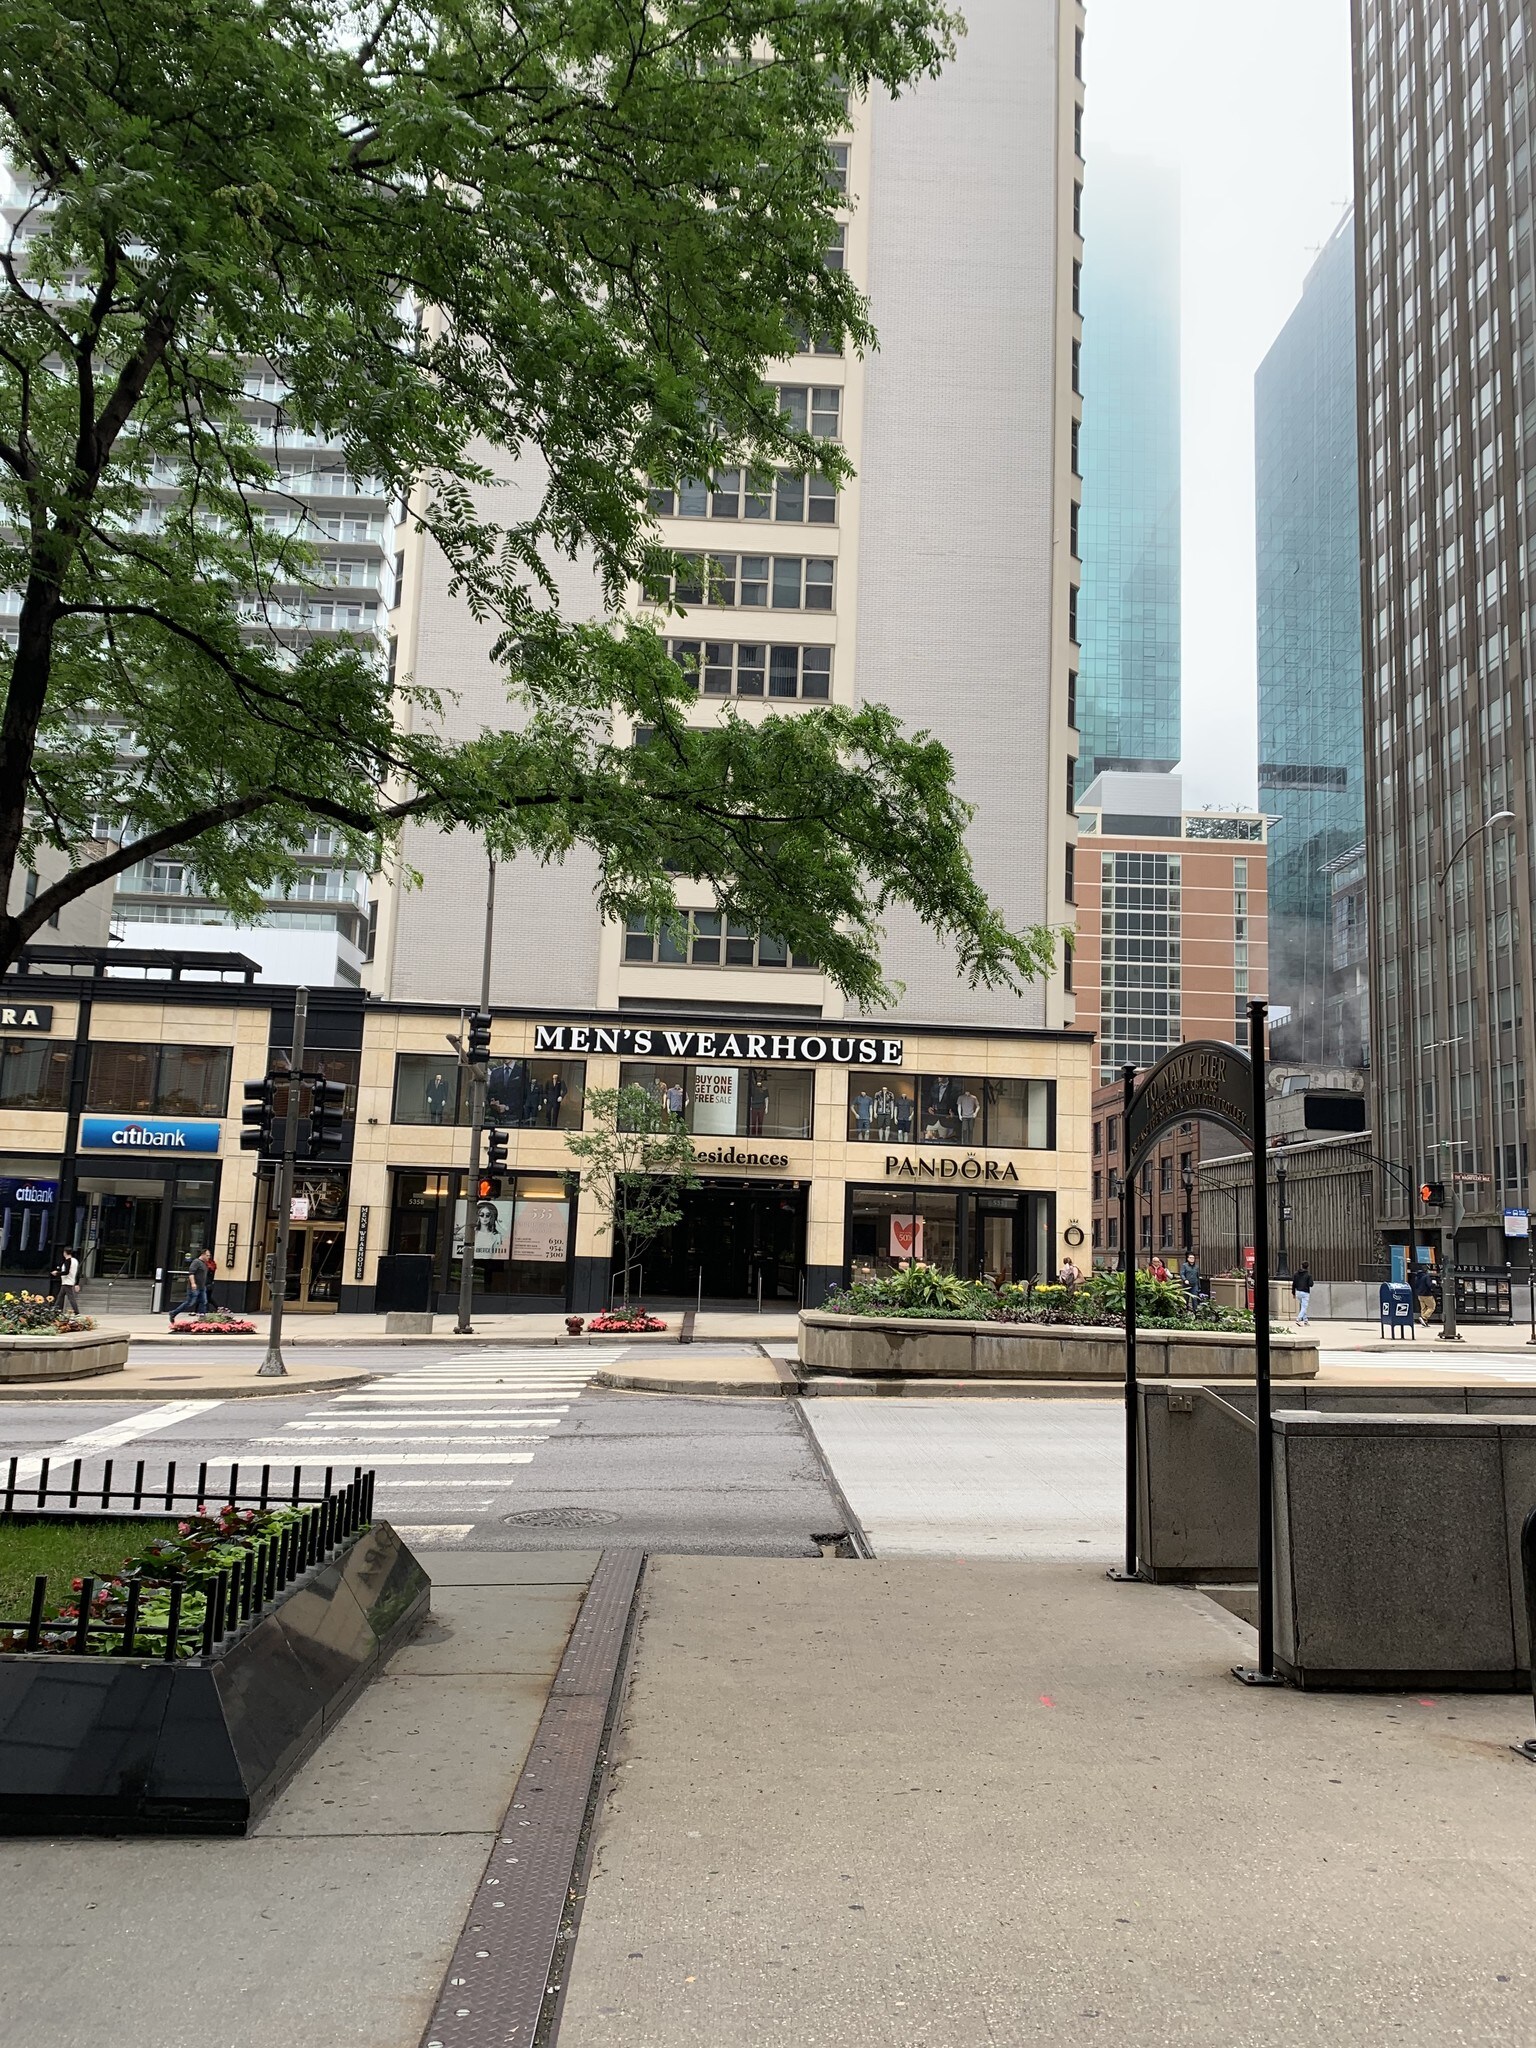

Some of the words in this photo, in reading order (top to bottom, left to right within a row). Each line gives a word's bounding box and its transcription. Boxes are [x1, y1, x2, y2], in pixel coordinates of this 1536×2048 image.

[1, 1008, 40, 1026] RA
[534, 1025, 652, 1055] MEN'S
[662, 1031, 903, 1065] WEARHOUSE
[694, 1084, 711, 1094] GET
[713, 1085, 732, 1095] ONE
[695, 1074, 712, 1085] BUY
[713, 1075, 733, 1086] ONE
[1144, 1080, 1158, 1108] TO
[1163, 1054, 1194, 1090] NAVY
[1199, 1053, 1226, 1082] PIER
[694, 1093, 714, 1104] FREE
[715, 1095, 732, 1105] SALE
[111, 1127, 186, 1147] citibank
[885, 1155, 1020, 1182] PANDORA
[15, 1185, 54, 1203] citibank
[226, 1223, 237, 1267] BANDERA
[356, 1230, 367, 1279] WEARHOUSE
